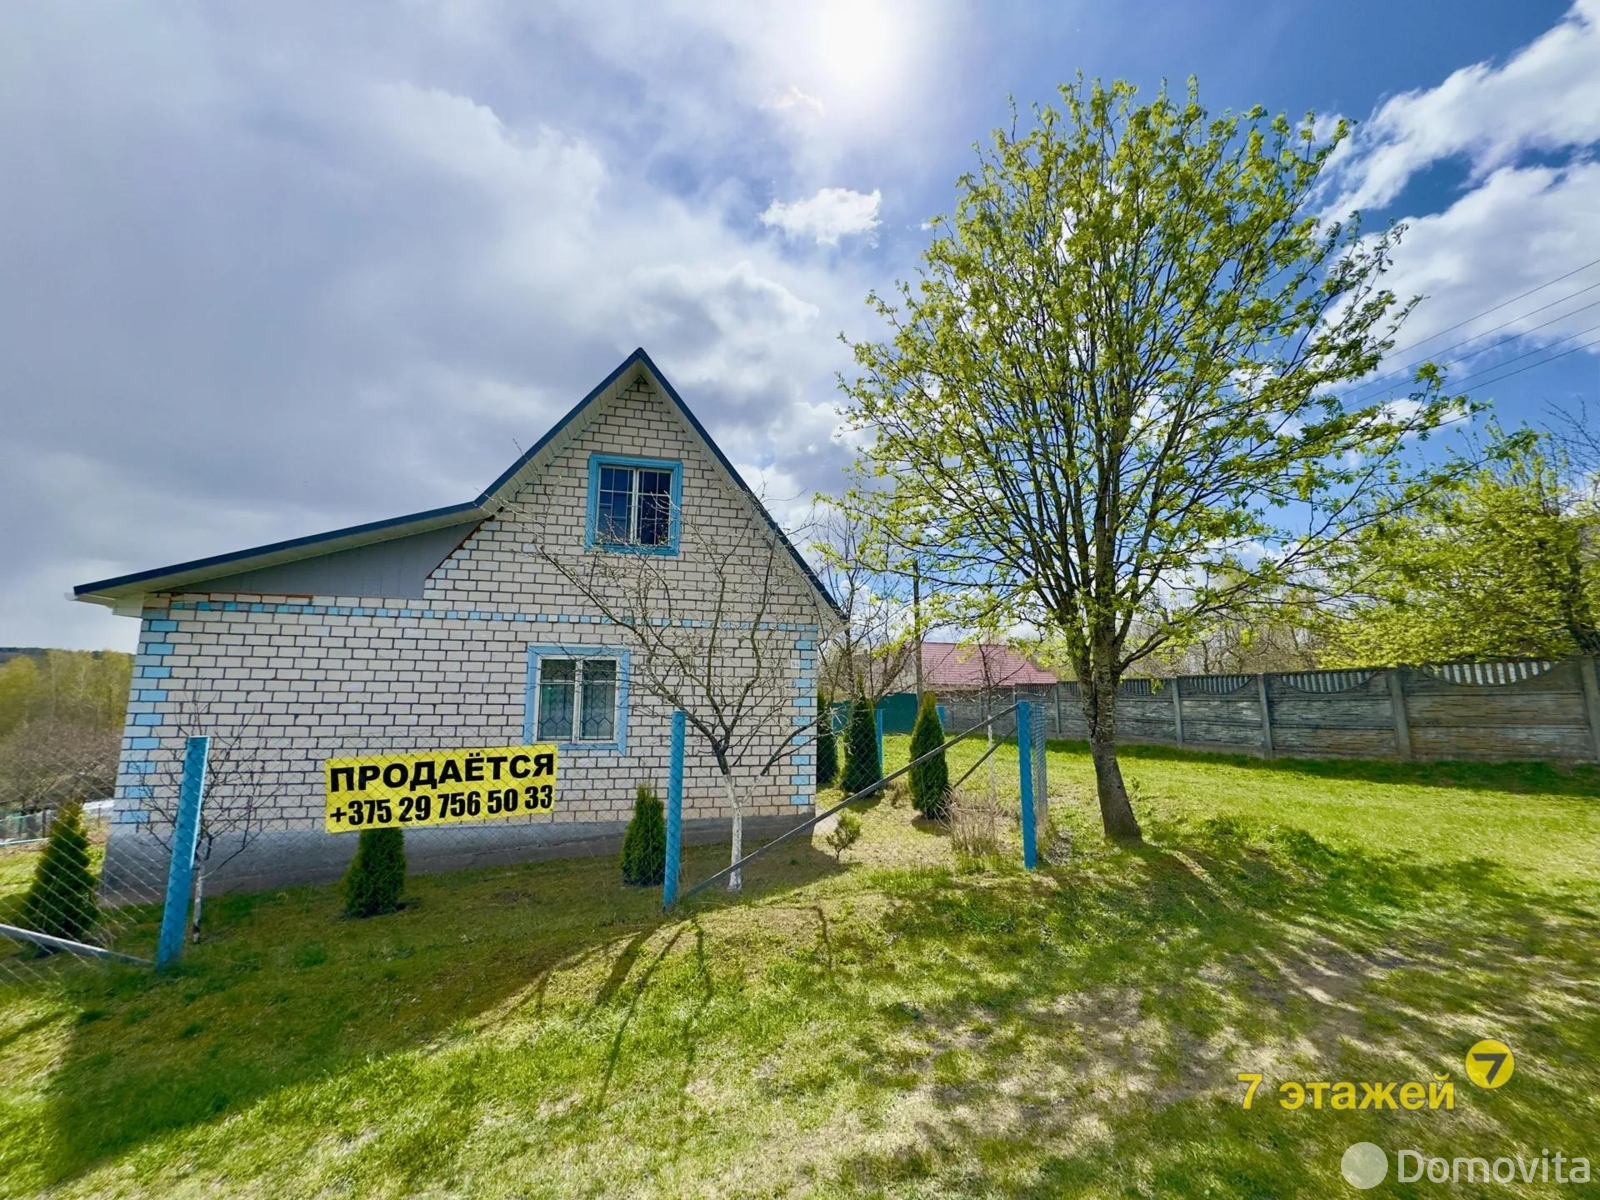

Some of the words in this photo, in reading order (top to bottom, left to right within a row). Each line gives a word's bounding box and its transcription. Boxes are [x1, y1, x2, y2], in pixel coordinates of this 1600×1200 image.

[330, 753, 555, 792] ПРОДАЁТСЯ
[330, 799, 392, 826] +375
[399, 795, 431, 823] 29
[437, 791, 481, 818] 756
[487, 789, 518, 814] 50
[524, 784, 553, 810] 33
